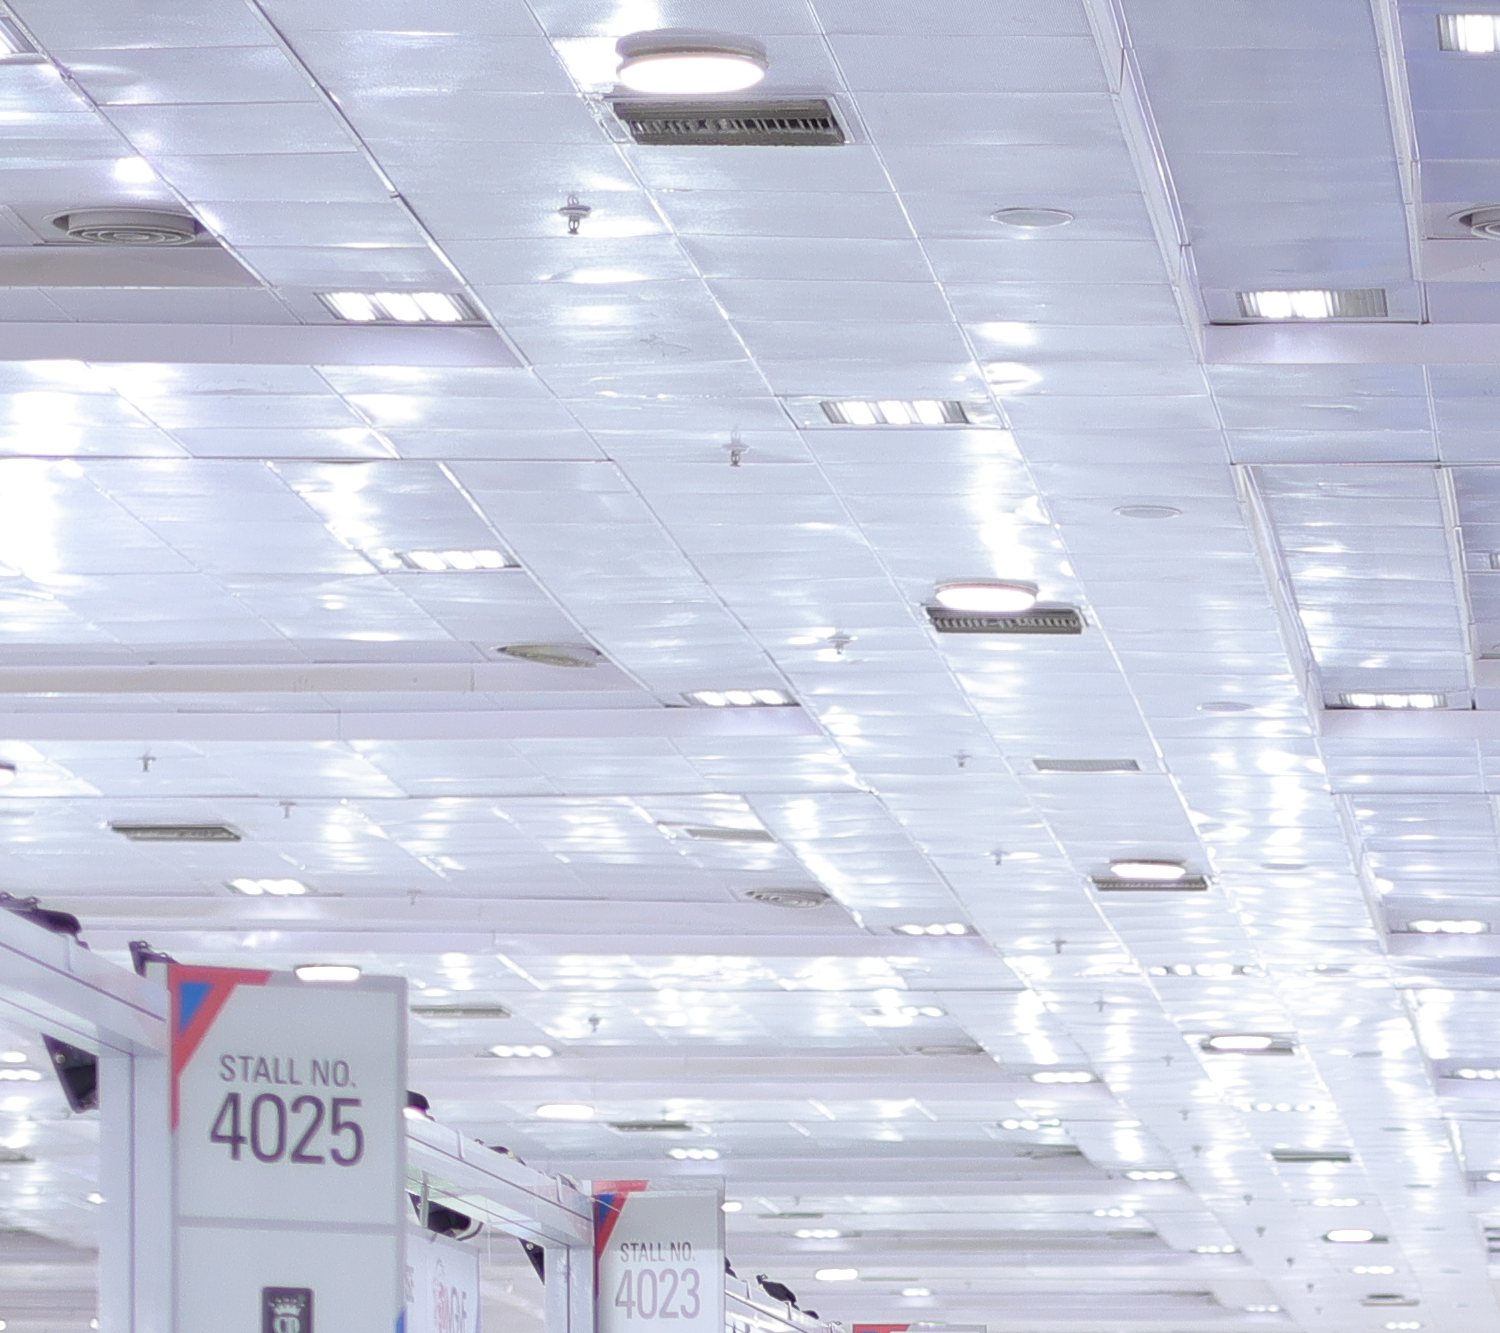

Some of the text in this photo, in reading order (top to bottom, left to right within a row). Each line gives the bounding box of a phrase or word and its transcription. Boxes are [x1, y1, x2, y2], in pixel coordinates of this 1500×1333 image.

[219, 1053, 357, 1089] STALL NO.
[209, 1091, 365, 1167] 4025
[620, 1241, 696, 1263] STALL NO.
[615, 1267, 700, 1320] 4023
